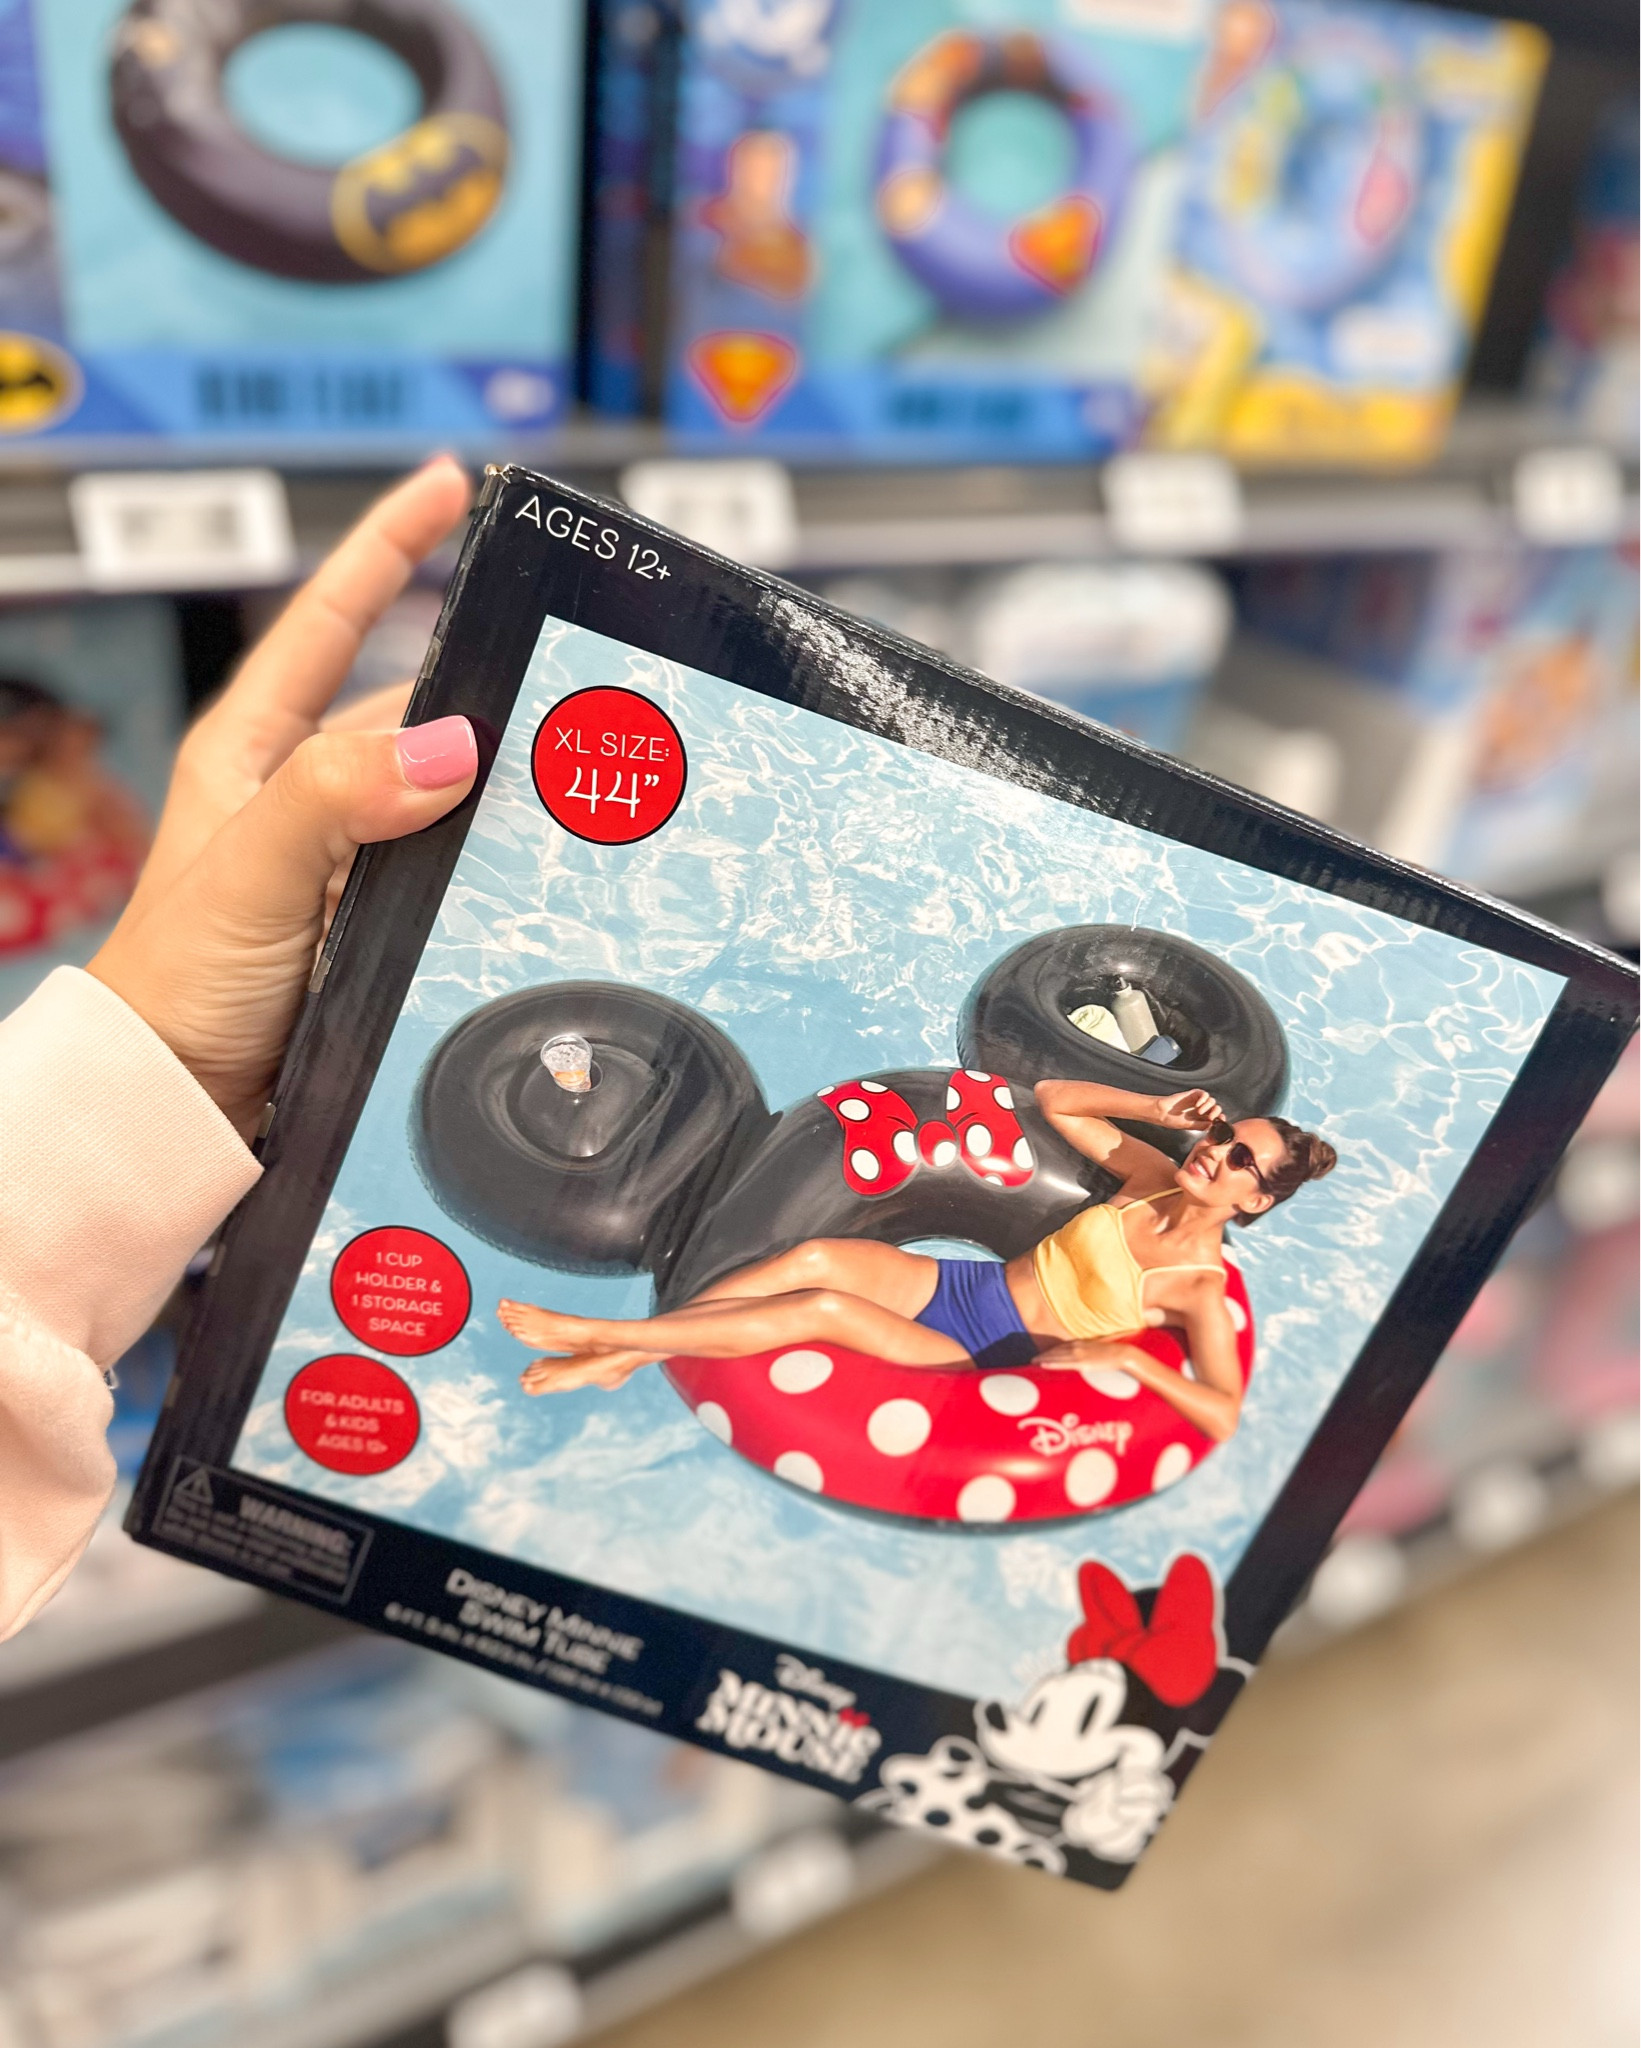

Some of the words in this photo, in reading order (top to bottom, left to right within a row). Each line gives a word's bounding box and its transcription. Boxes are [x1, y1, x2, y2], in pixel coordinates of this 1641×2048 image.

[515, 495, 620, 560] AGES
[627, 543, 671, 580] 12+
[554, 726, 591, 754] XL
[600, 731, 670, 762] SIZE:
[376, 1251, 382, 1264] 1
[385, 1252, 423, 1267] CUP
[355, 1271, 427, 1292] HOLDER
[429, 1280, 442, 1293] &
[351, 1294, 358, 1306] 1
[361, 1294, 443, 1316] STORAGE
[368, 1317, 426, 1337] SPACE
[300, 1389, 336, 1407] FOR
[337, 1394, 405, 1415] ADULTS
[338, 1415, 380, 1434] KIDS
[316, 1434, 364, 1453] AGES
